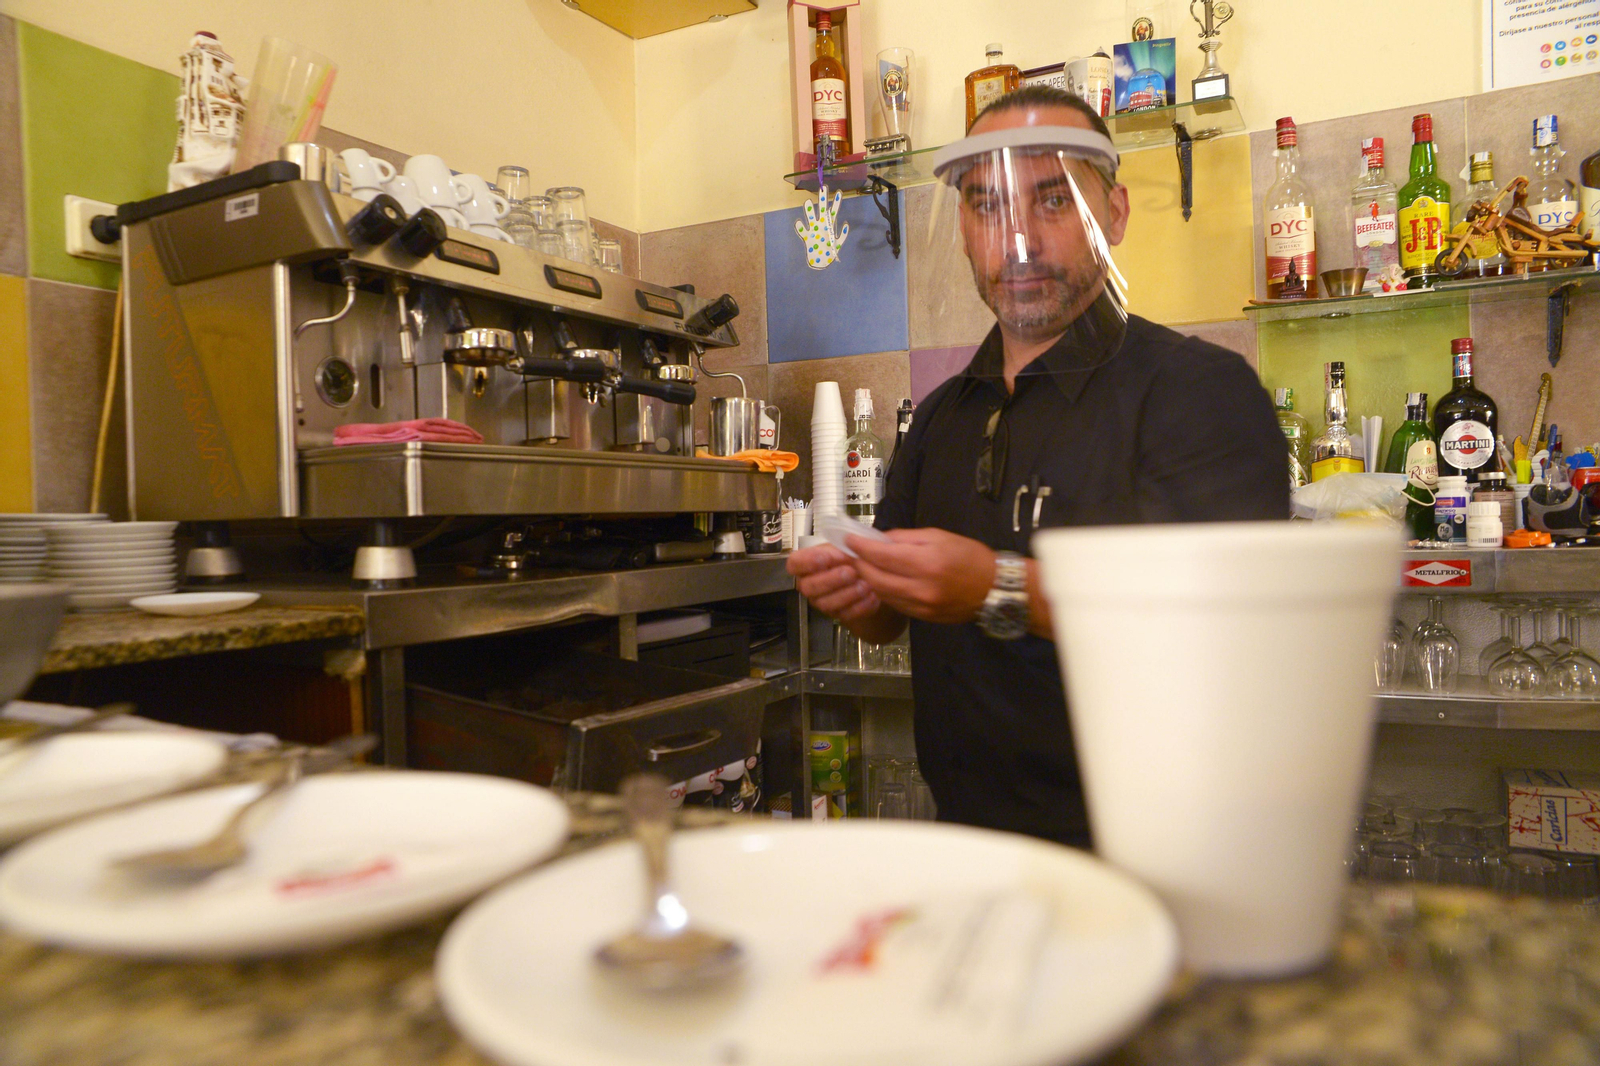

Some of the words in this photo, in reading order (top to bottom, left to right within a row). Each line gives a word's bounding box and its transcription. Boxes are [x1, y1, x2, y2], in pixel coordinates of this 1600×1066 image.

[1509, 8, 1546, 21] presencia
[1515, 4, 1533, 12] para
[1534, 19, 1564, 30] nuestro
[1564, 11, 1600, 25] personal
[813, 89, 843, 103] DYC
[1413, 211, 1434, 219] RARE
[1538, 211, 1573, 225] DYC
[1270, 219, 1308, 237] DYC
[1356, 220, 1395, 235] BEEFEATER
[1405, 216, 1444, 253] J&B
[1446, 438, 1490, 451] MARTINI
[1415, 569, 1461, 577] METALFRIO
[1545, 799, 1564, 842] Caricias
